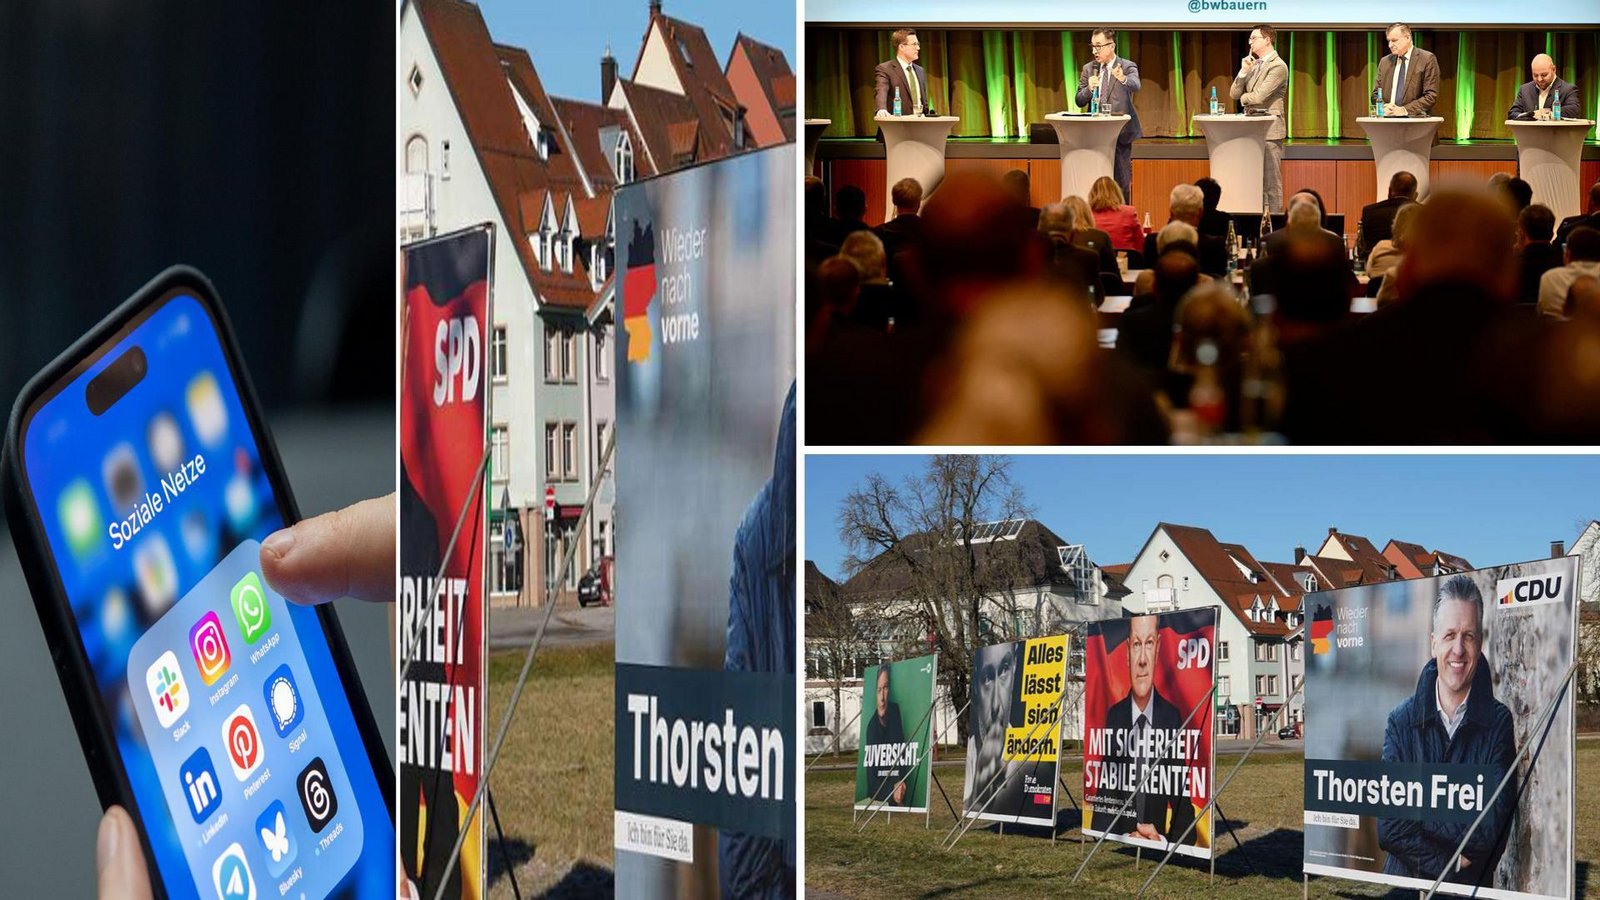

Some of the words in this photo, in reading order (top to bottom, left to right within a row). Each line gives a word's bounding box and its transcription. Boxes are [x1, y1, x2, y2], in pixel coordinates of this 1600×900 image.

[1187, 0, 1268, 13] @bwbauern
[660, 225, 707, 264] Wieder
[661, 268, 692, 305] nach
[661, 312, 699, 344] vorne
[433, 314, 481, 408] SPD
[108, 491, 164, 550] Soziale
[160, 453, 207, 504] Netze
[1514, 576, 1562, 603] CDU
[400, 575, 468, 666] RHEIT
[1337, 605, 1369, 621] Wieder
[1337, 620, 1359, 635] nach
[249, 633, 280, 664] WhatsApp
[1026, 642, 1064, 666] Alles
[1177, 636, 1211, 671] SPD
[1337, 635, 1364, 649] vorne
[209, 674, 239, 706] Instagram
[1024, 672, 1061, 696] lässt
[1027, 702, 1060, 726] sich
[172, 720, 191, 742] Slack
[288, 730, 307, 753] Signal
[1088, 728, 1114, 757] MIT
[1115, 728, 1202, 761] SICHERHEIT
[627, 693, 785, 801] Thorsten
[863, 742, 920, 767] ZUVERSICHT.
[243, 768, 272, 800] Pinterest
[1085, 760, 1137, 793] STABILE
[1140, 763, 1207, 799] RENTEN
[1312, 769, 1424, 808] Thorsten
[1430, 773, 1485, 812] Frei
[201, 813, 230, 846] LinkedIn
[319, 822, 344, 852] Threads
[665, 827, 678, 851] Sie
[278, 867, 303, 896] Bluesky
